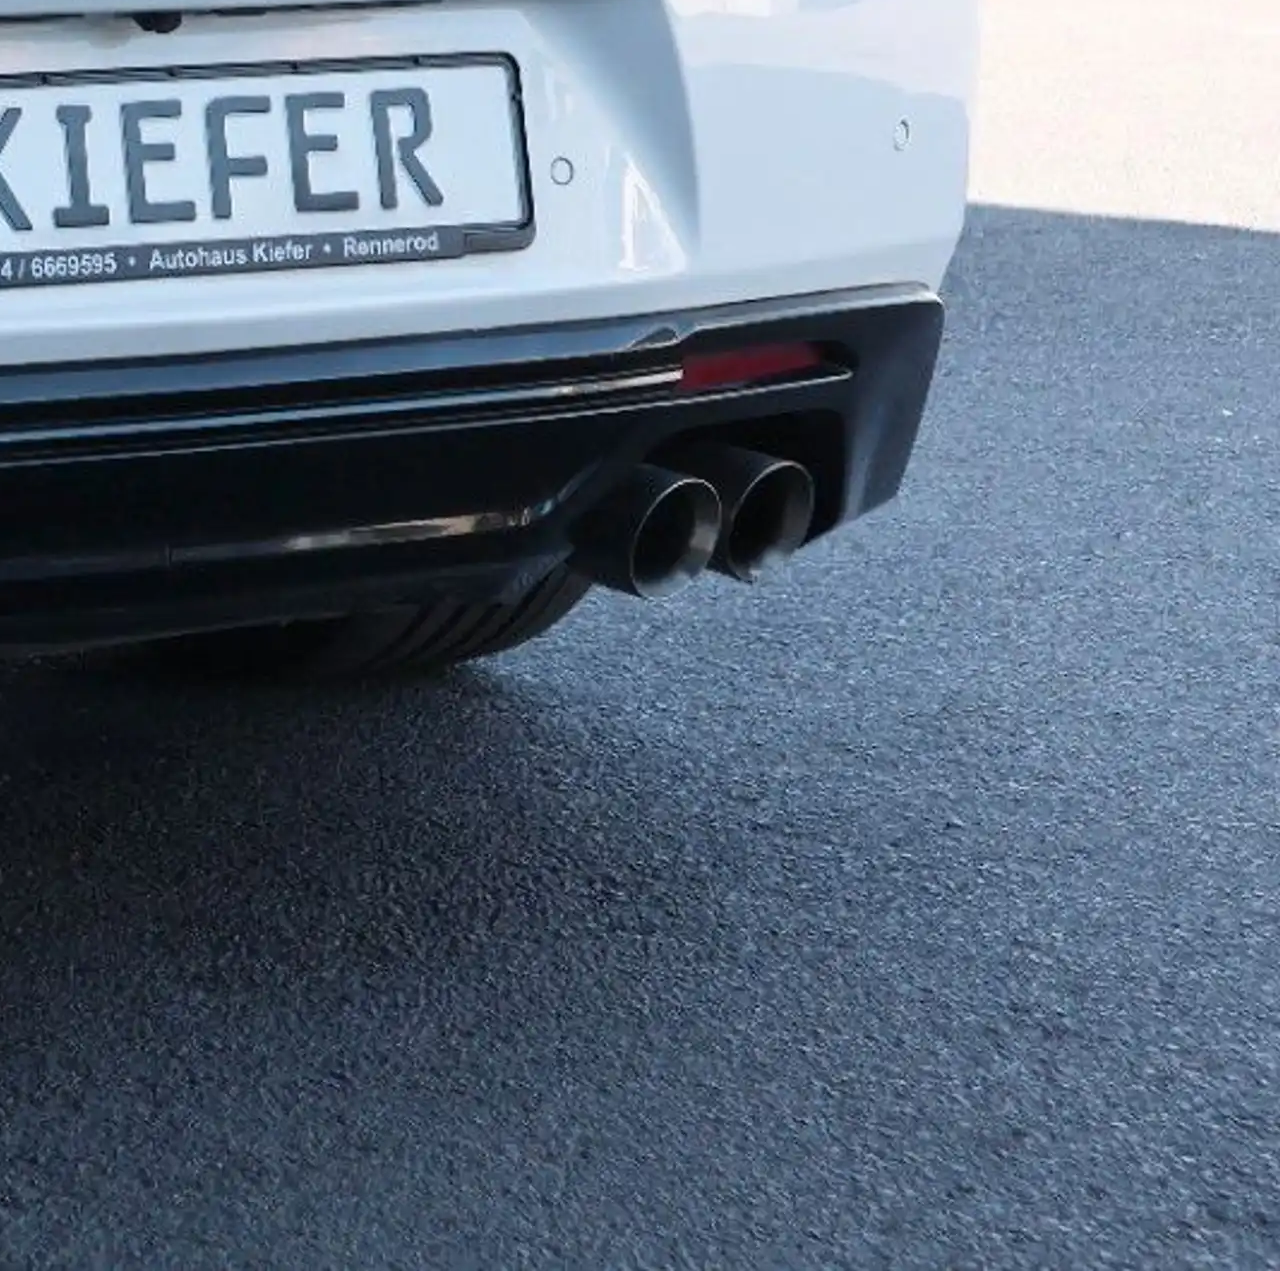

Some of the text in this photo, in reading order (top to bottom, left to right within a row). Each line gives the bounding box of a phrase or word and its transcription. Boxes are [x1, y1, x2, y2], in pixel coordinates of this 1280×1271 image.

[30, 252, 118, 278] 6669595
[149, 246, 246, 270] Autohaus
[252, 240, 313, 263] Kiefer
[343, 231, 439, 257] Rennerod
